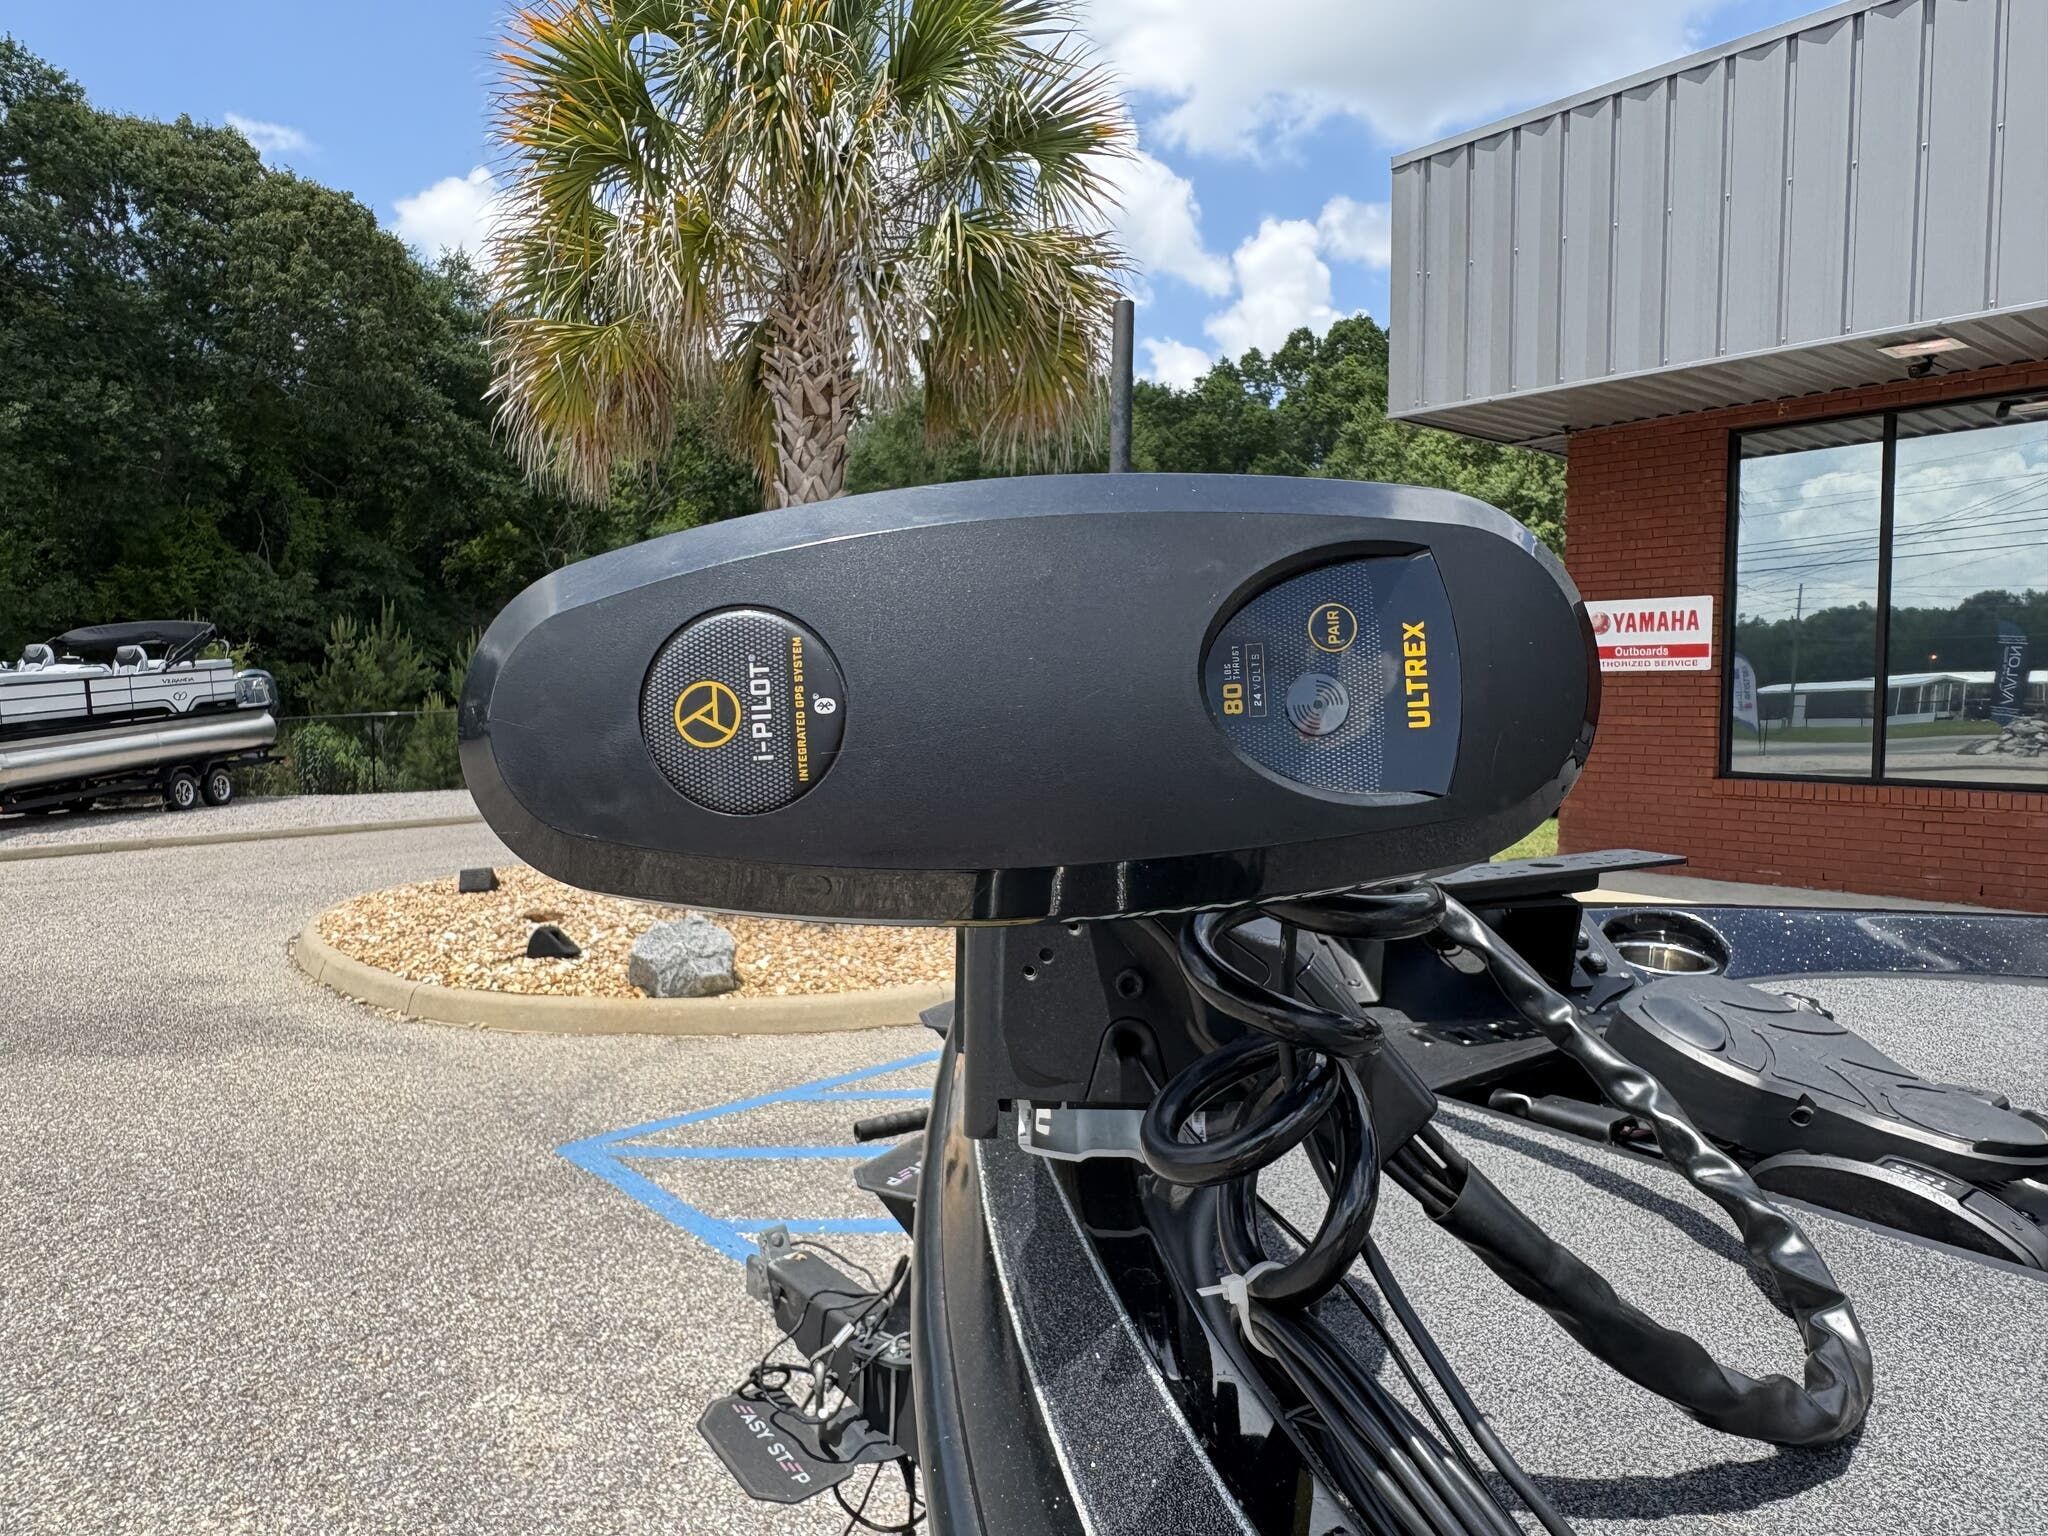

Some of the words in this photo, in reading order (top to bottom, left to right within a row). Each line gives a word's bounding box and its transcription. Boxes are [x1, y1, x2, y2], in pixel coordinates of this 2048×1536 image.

[1327, 610, 1341, 645] PAIR
[1613, 609, 1700, 633] YAMAHA
[791, 636, 804, 682] SYSTEM
[1231, 645, 1241, 680] THRUST
[1602, 660, 1651, 668] THORIZED
[1654, 659, 1699, 667] SERVICE
[1615, 646, 1669, 657] Outboards
[1223, 663, 1232, 680] LBS
[1251, 653, 1261, 691] VOLTS
[1402, 620, 1431, 729] ULTREX
[794, 685, 805, 708] GPS
[1222, 683, 1243, 715] 80
[1253, 693, 1262, 707] 24
[795, 711, 809, 782] INTEGRATED
[731, 1404, 775, 1439] EASY
[767, 1442, 811, 1484] STEP
